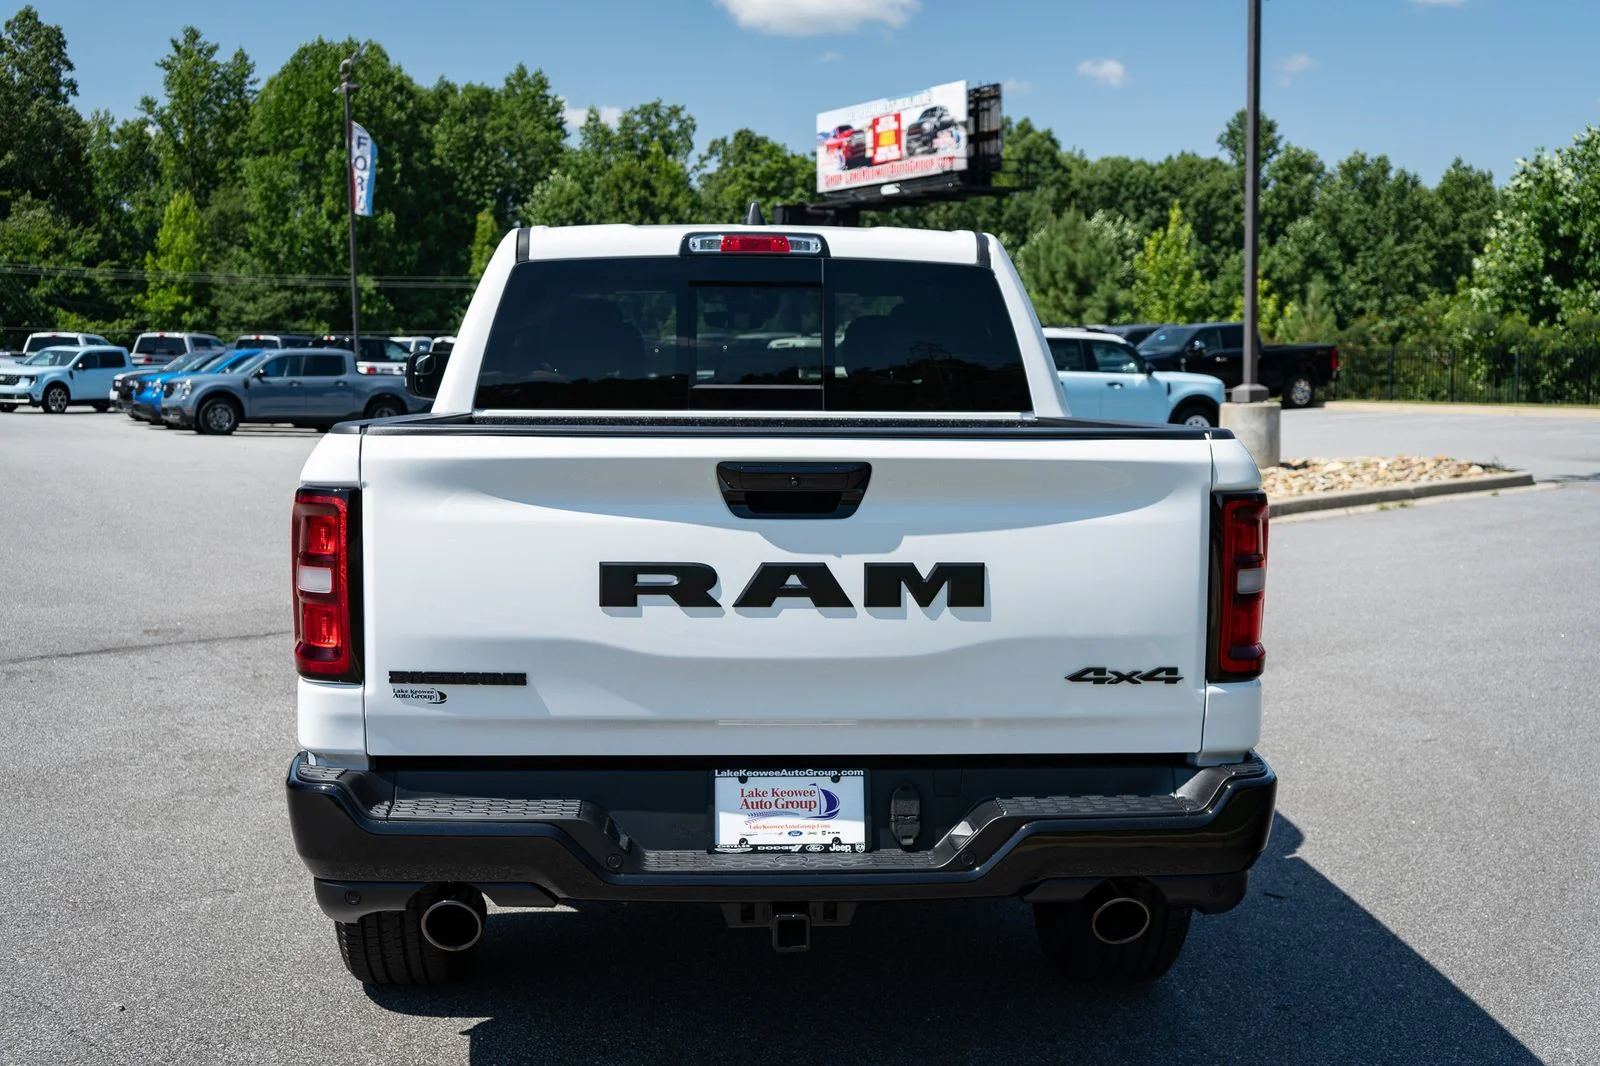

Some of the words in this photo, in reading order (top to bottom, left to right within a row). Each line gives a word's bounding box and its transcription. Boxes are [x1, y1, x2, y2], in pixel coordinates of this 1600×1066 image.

[599, 561, 986, 608] RAM
[1064, 666, 1184, 685] 4x4
[411, 693, 435, 701] Group
[715, 769, 864, 777] LakeKeoweeAutoGroup.com
[740, 787, 769, 798] Lake
[771, 787, 816, 798] Keowee
[739, 798, 772, 810] Auto
[774, 798, 817, 811] Group
[829, 844, 851, 853] Jeep
